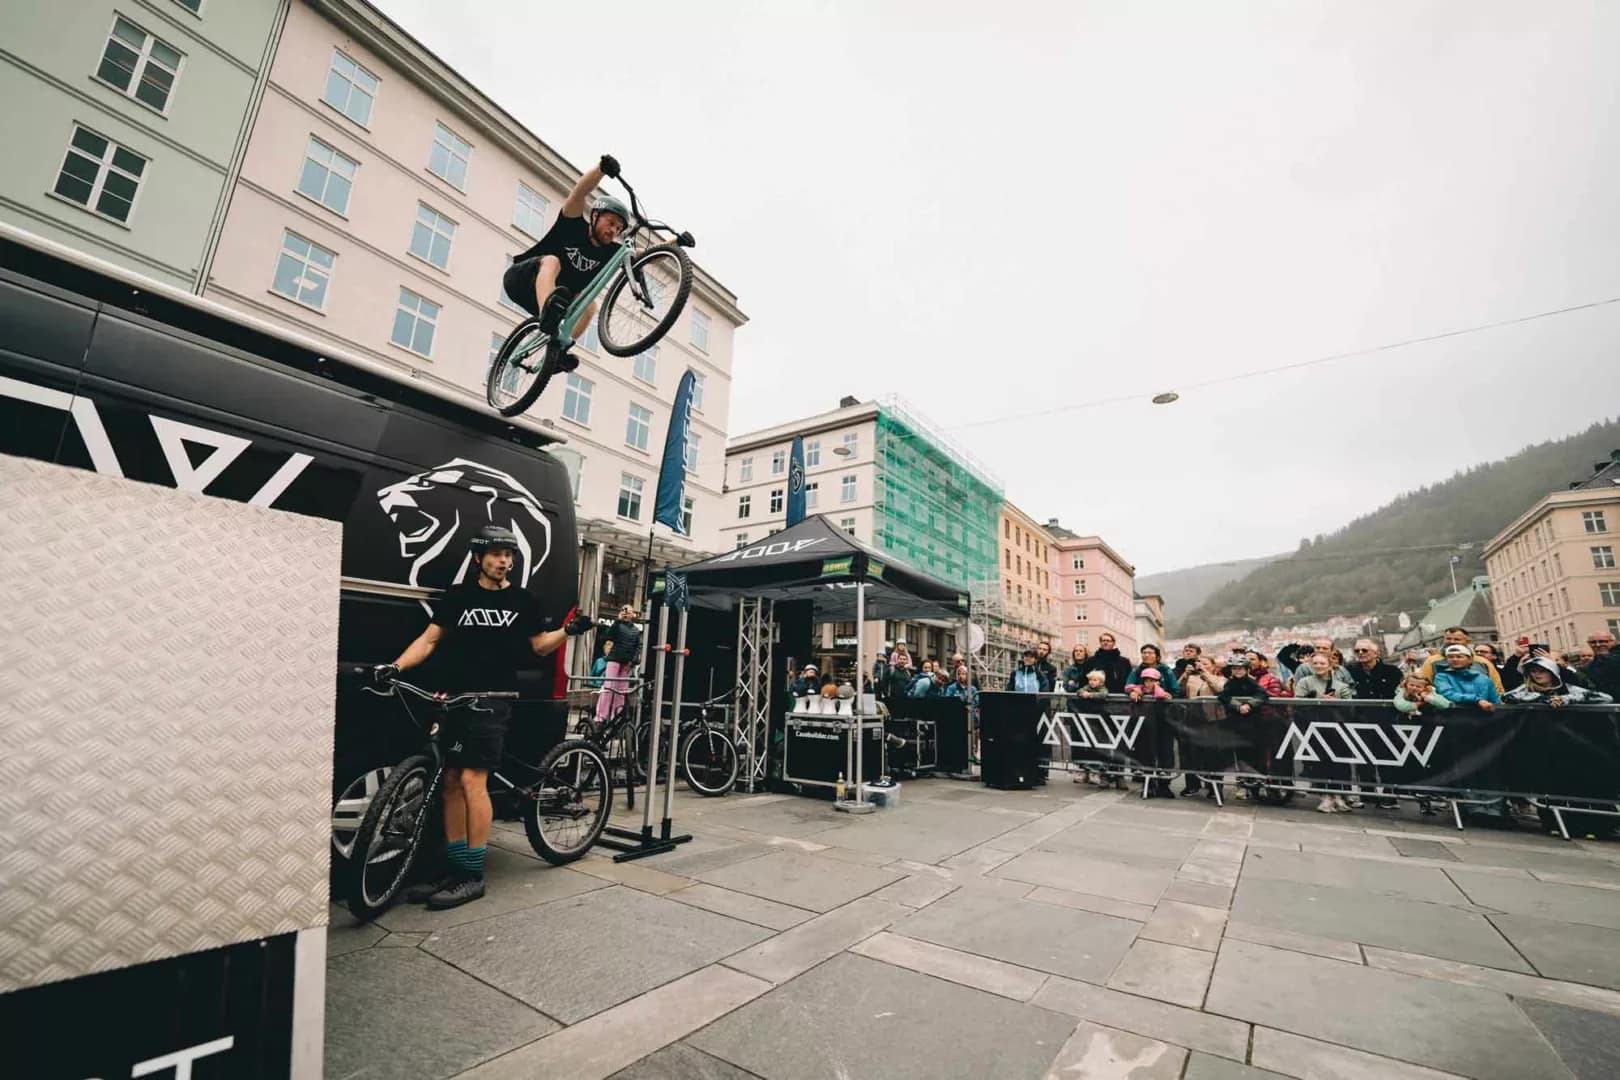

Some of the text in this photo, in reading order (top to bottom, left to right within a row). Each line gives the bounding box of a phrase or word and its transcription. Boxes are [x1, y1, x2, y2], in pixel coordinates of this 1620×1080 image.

[457, 607, 519, 627] MOOW
[1036, 711, 1146, 751] MOOW
[1274, 720, 1445, 768] MOOW
